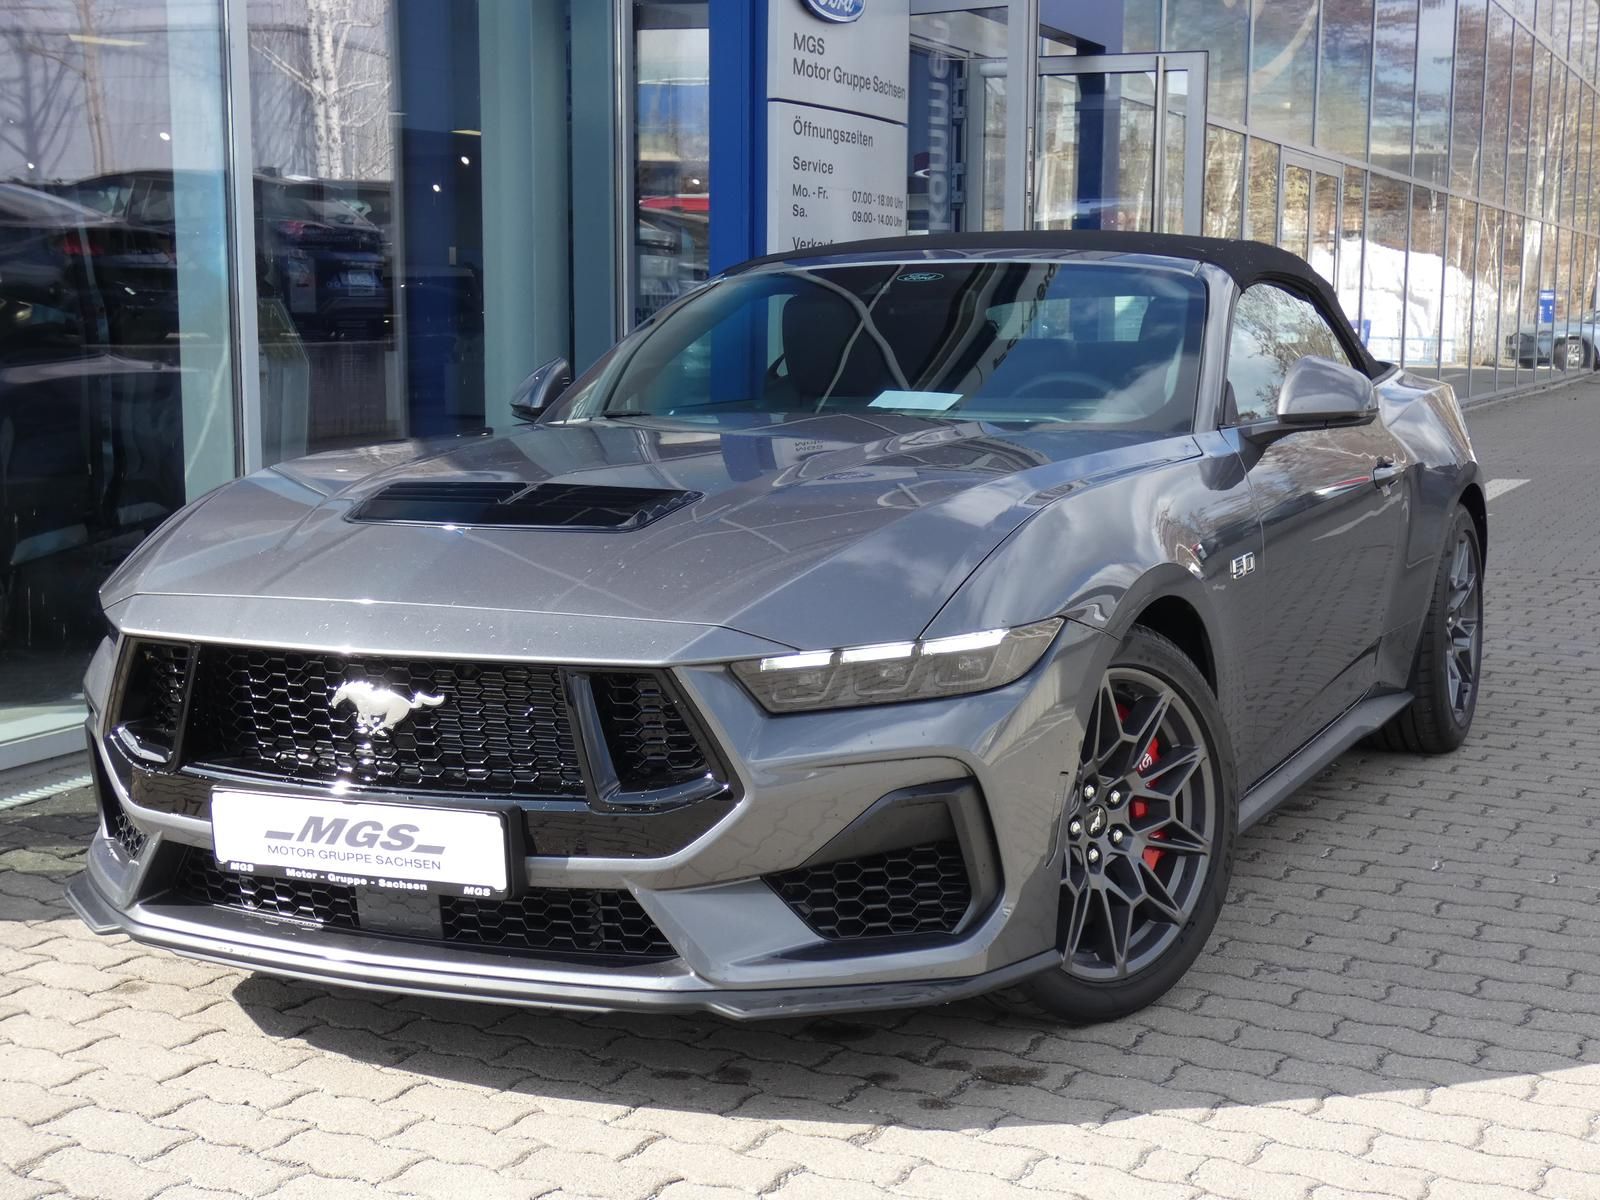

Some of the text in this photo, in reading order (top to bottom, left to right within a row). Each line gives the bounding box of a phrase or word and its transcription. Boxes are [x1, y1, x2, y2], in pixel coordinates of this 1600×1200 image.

[793, 32, 825, 55] MGS
[793, 57, 906, 99] Motor Gruppe Sachsen
[793, 115, 874, 147] Öffnungszeiten
[792, 155, 833, 175] Service
[792, 183, 811, 198] Mo.
[817, 186, 829, 200] Fr.
[852, 190, 873, 205] 07.00
[792, 203, 808, 218] Sa.
[852, 210, 873, 224] 09.00
[792, 236, 833, 251] Verk
[296, 815, 420, 851] MGS
[230, 861, 254, 872] MGS
[267, 844, 441, 870] MOTOR GRUPPE SACHSEN
[285, 867, 317, 880] Motor
[327, 872, 367, 886] Gruppe
[378, 879, 428, 892] Sachsen
[463, 886, 491, 897] MGS
